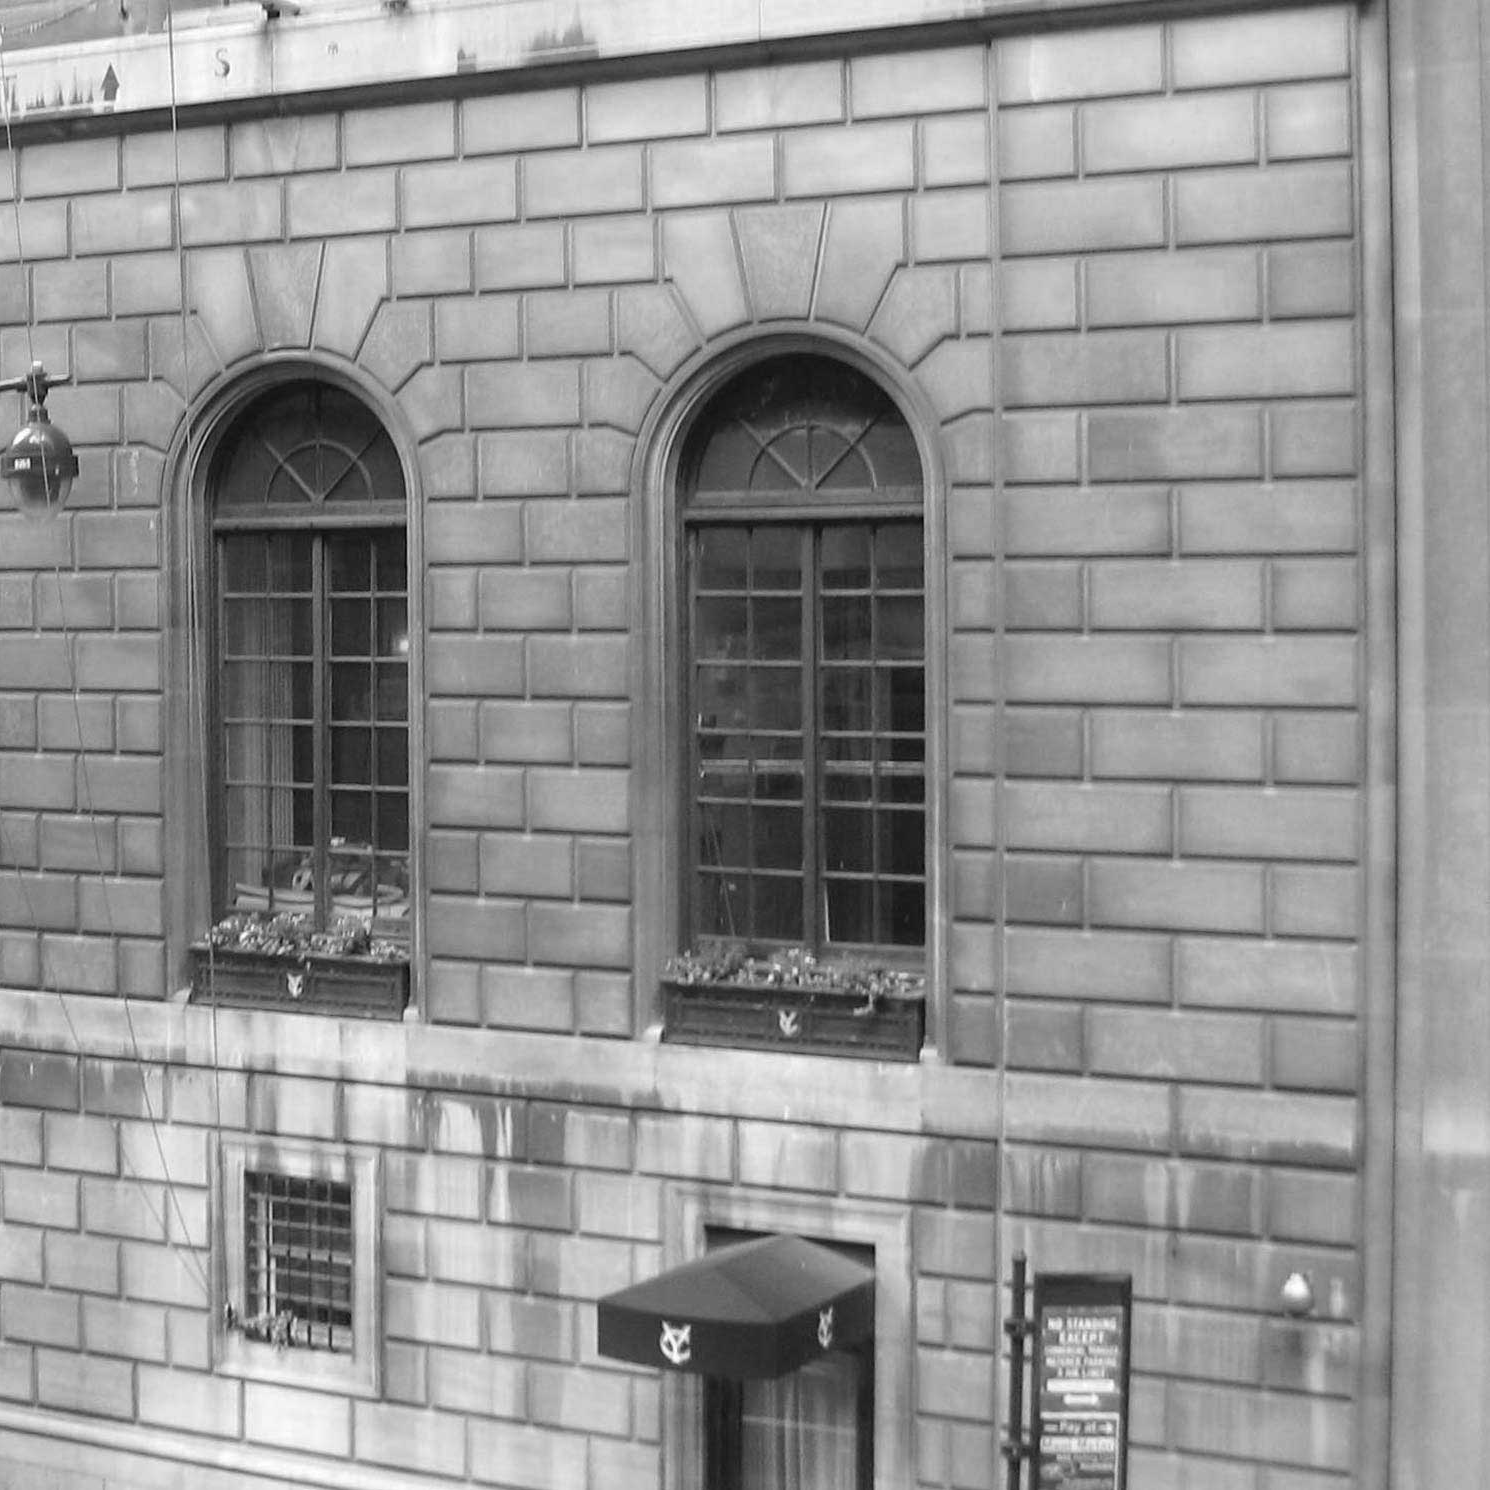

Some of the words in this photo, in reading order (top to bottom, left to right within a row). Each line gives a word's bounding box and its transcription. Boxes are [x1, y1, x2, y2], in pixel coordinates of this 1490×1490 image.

[1048, 1317, 1062, 1330] NO
[1066, 1317, 1117, 1331] STANDING
[1059, 1330, 1104, 1344] EXCEPT
[1059, 1421, 1081, 1434] Pay
